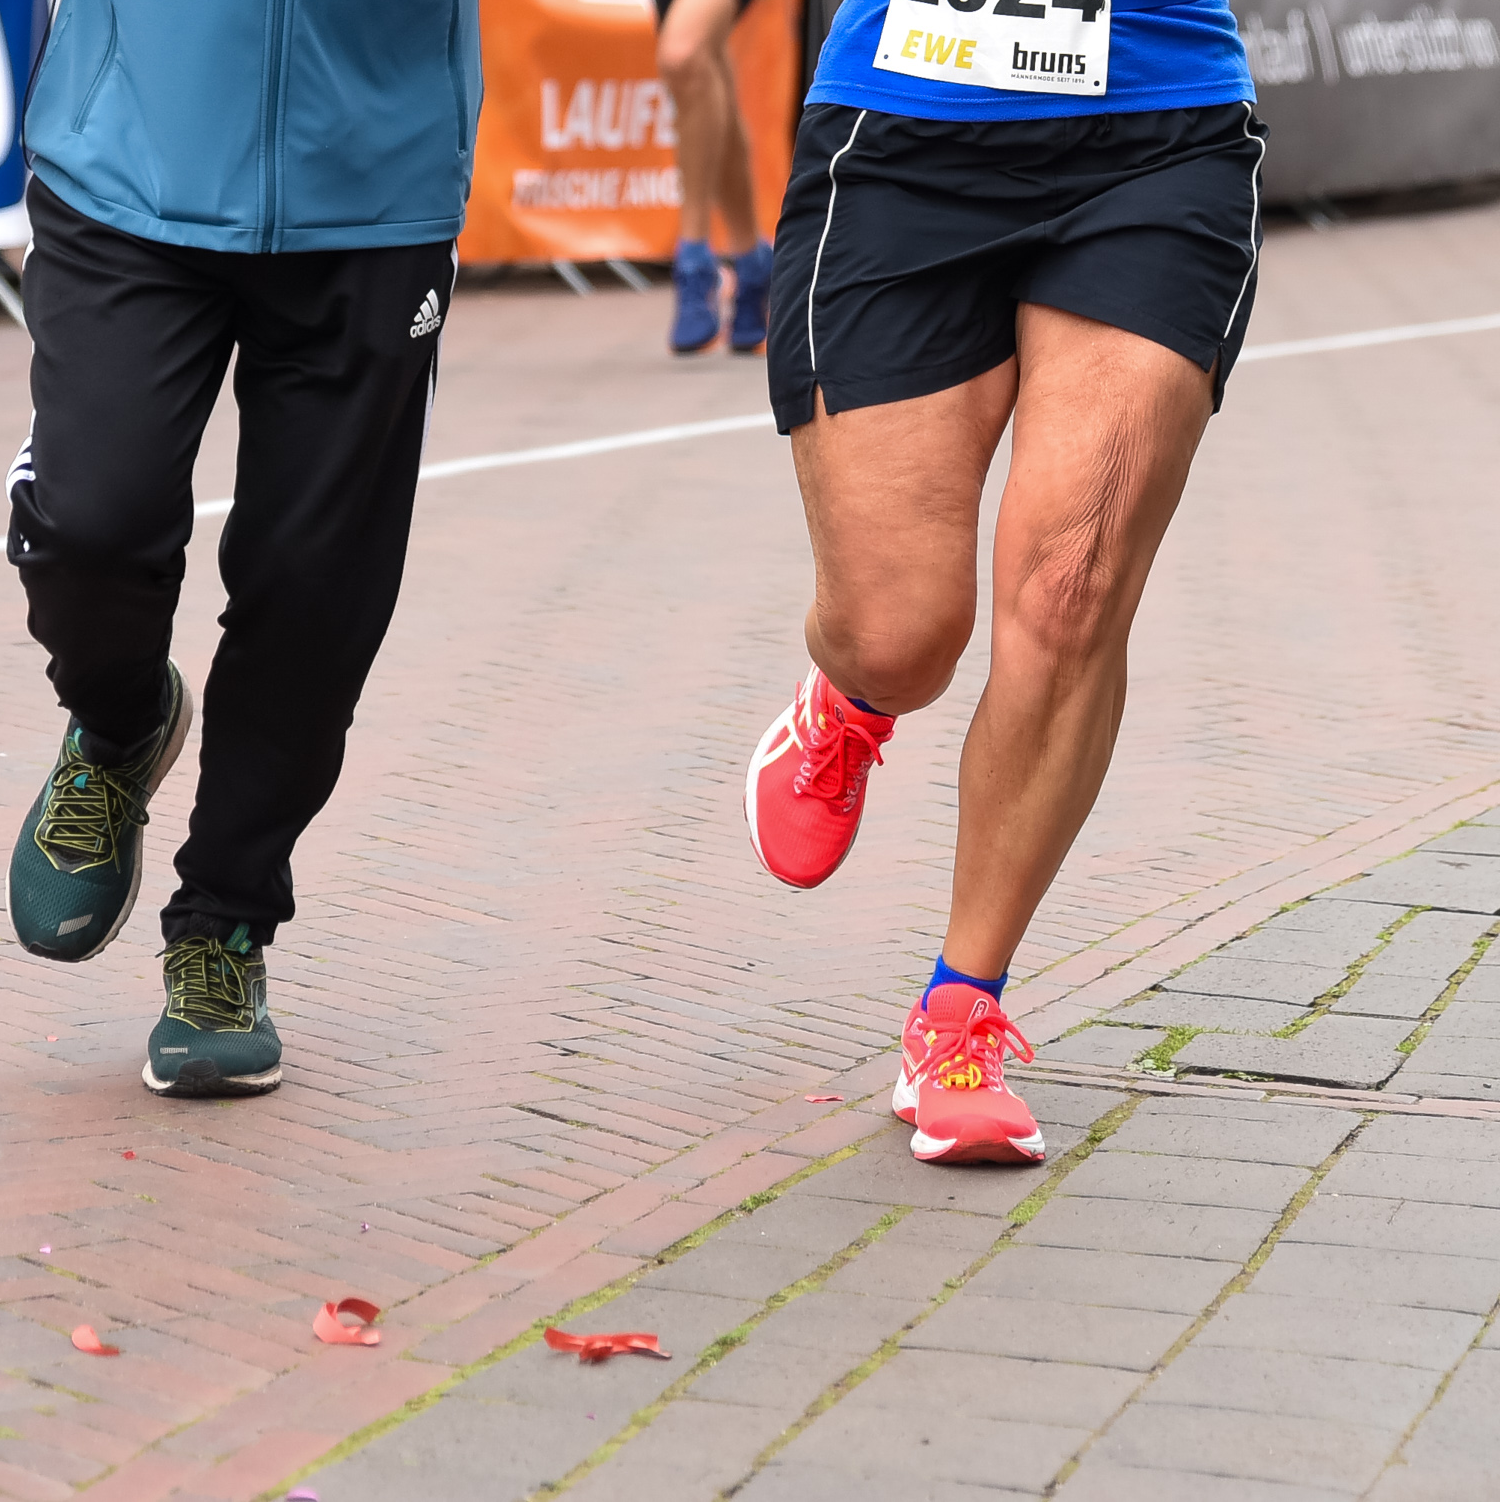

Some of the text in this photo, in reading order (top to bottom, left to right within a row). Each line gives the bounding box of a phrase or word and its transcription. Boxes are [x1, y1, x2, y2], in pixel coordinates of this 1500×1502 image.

[900, 28, 978, 70] EWE
[1012, 41, 1087, 75] bruns
[1071, 76, 1086, 84] 1896
[409, 314, 442, 339] adidas
